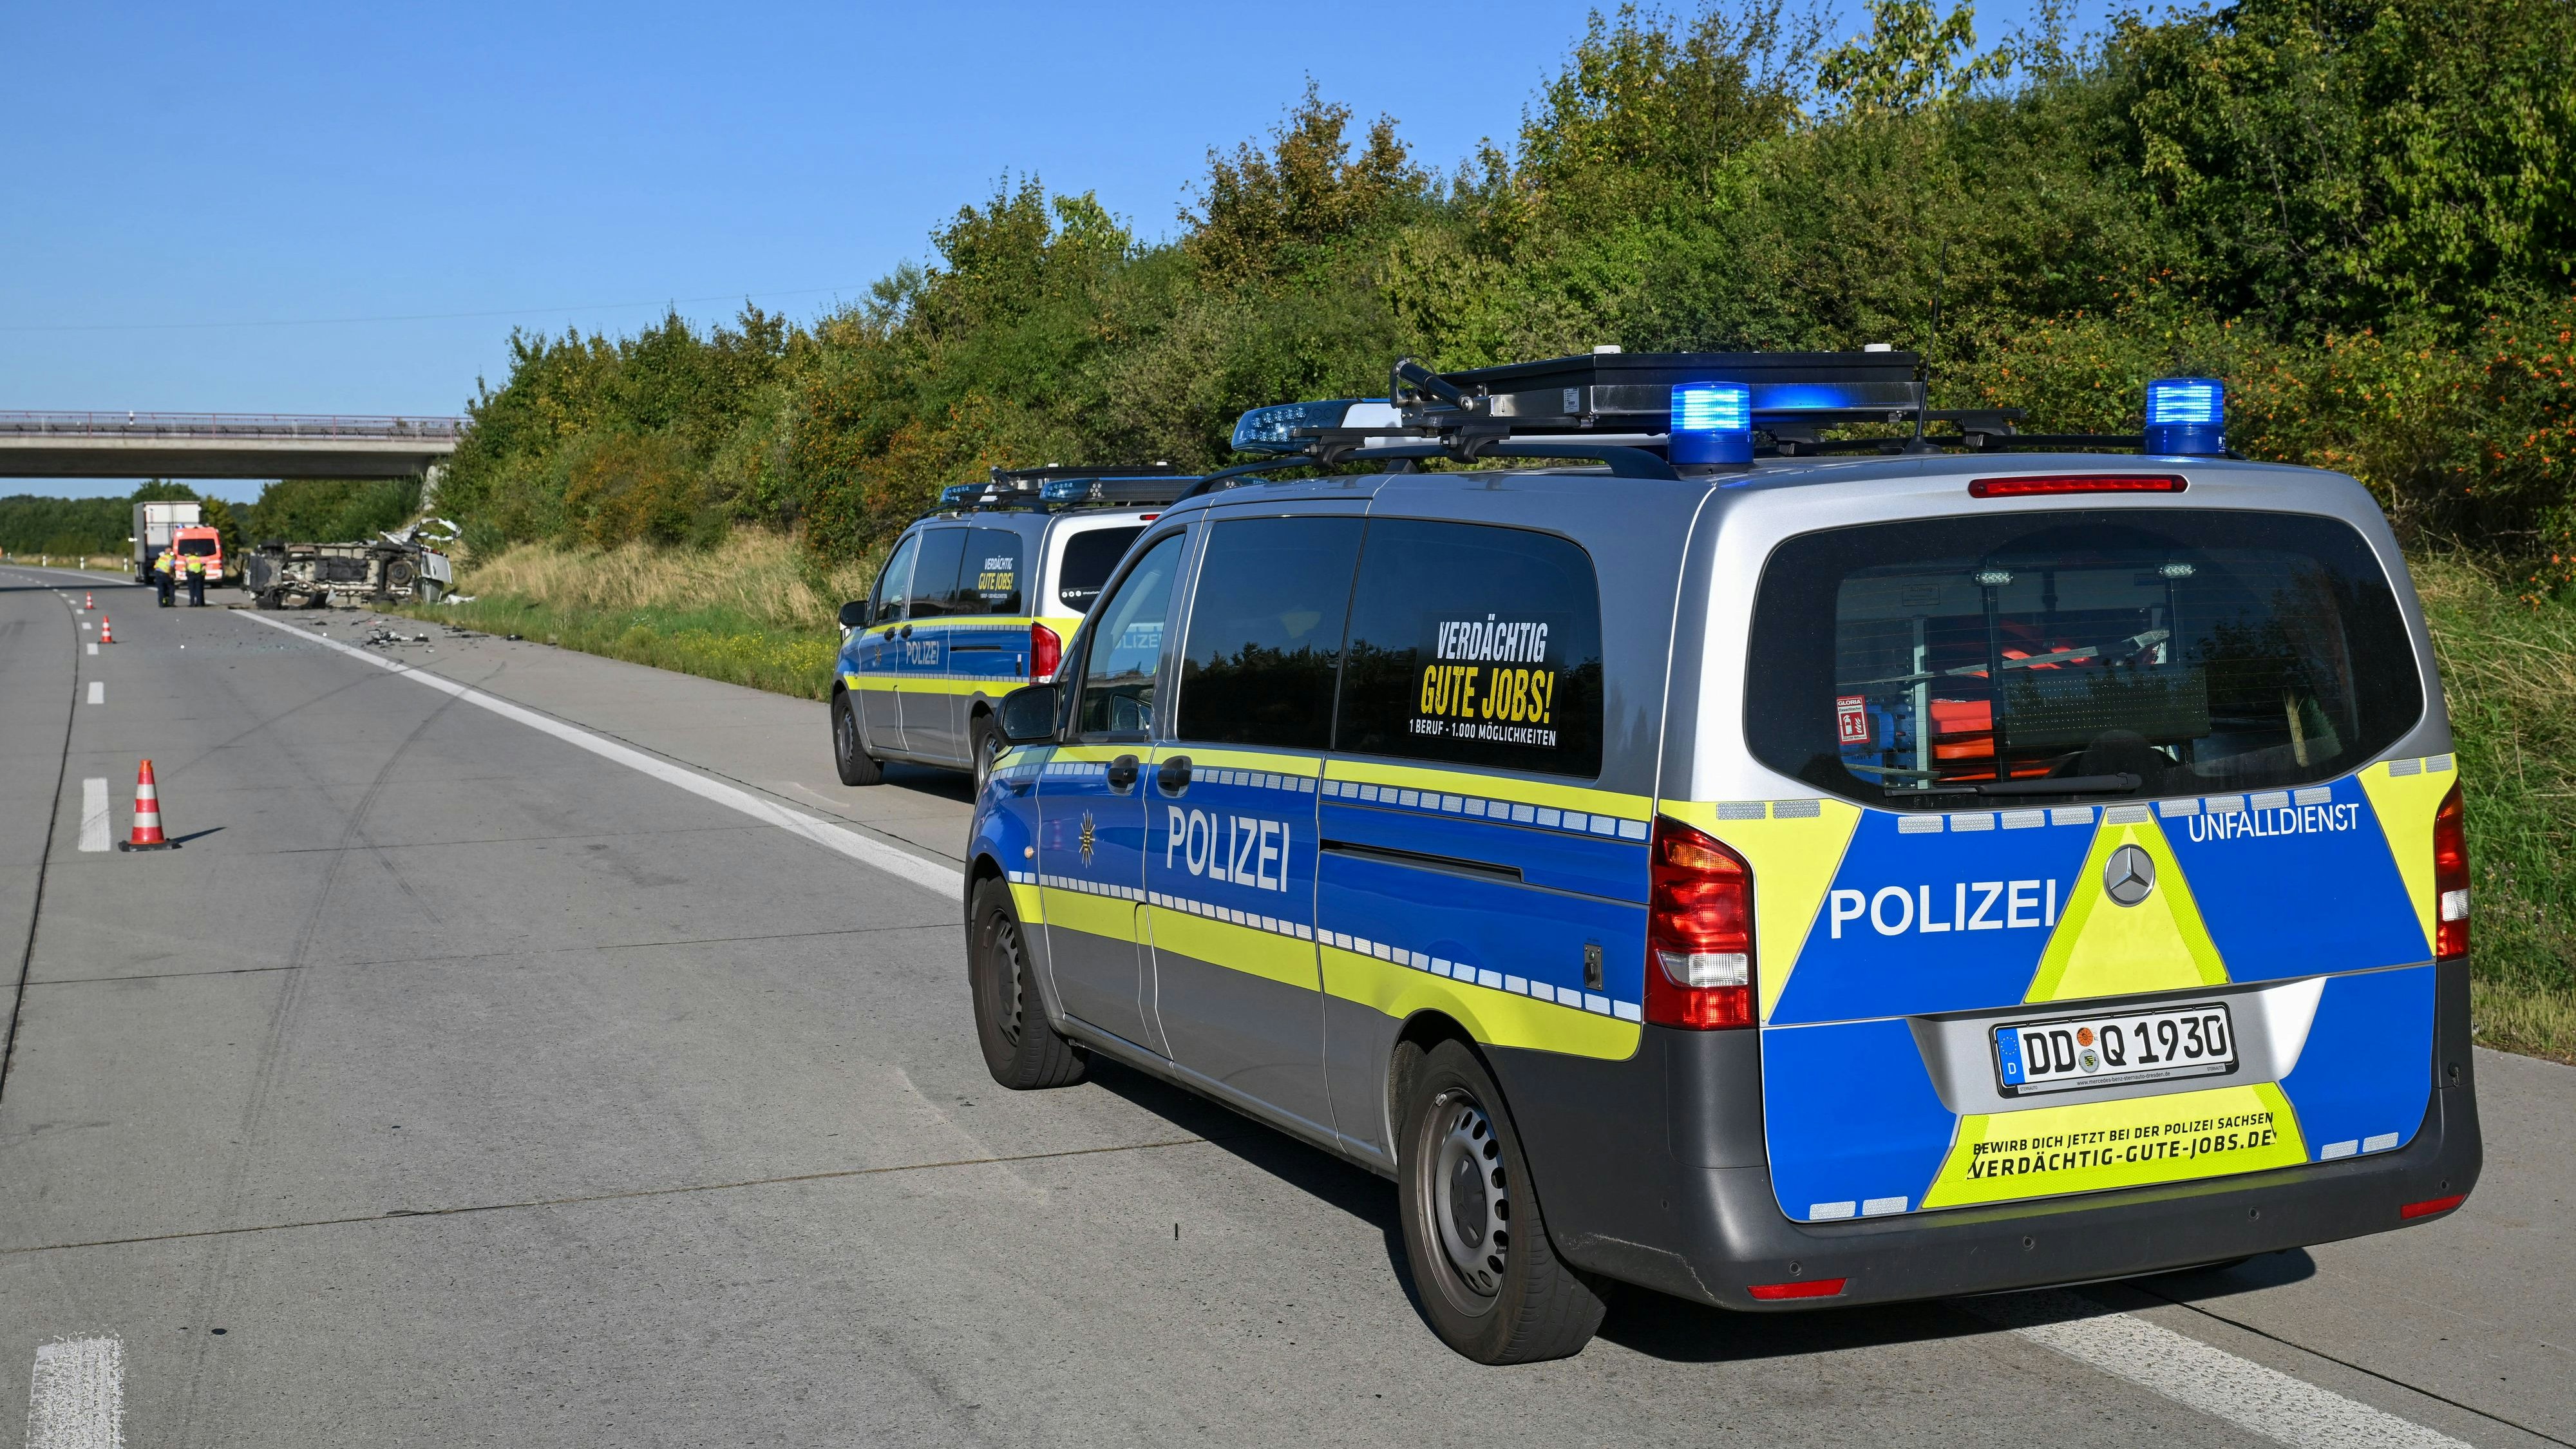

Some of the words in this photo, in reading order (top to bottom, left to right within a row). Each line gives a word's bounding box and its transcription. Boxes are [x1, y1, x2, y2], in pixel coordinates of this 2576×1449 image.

[978, 573, 996, 590] GUTE
[995, 572, 1014, 591] JOBS!
[906, 641, 939, 665] POLIZEI
[1437, 614, 1548, 662] VERDÄCHTIG
[1421, 665, 1479, 717] GUTE
[1482, 668, 1554, 724] JOBS!
[1410, 719, 1414, 733] 1
[1416, 719, 1444, 735] BERUF
[1452, 723, 1476, 739] 1.000
[1478, 722, 1557, 746] MÖGLICHKEITEN
[2188, 803, 2359, 842] UNFALLDIENST
[1167, 805, 1290, 893] POLIZEI
[1830, 878, 2056, 939] POLIZEI
[2007, 1062, 2017, 1075] D
[2023, 1030, 2076, 1075] DD
[2099, 1025, 2127, 1066] Q
[2134, 1015, 2227, 1064] 1930
[2076, 1072, 2171, 1086] www.mercedes-benz-sternauto-dresden.de
[1971, 1130, 2272, 1179] VERDÄCHTIG-GUTE-JOBS.DE
[1973, 1139, 2027, 1155] BEWIRB
[2032, 1135, 2063, 1150] DICH
[2067, 1132, 2105, 1148] JETZT
[2109, 1129, 2129, 1141] BEI
[2134, 1126, 2159, 1139] DER
[2164, 1119, 2213, 1135] POLIZEI
[2217, 1112, 2273, 1129] SACHSEN
